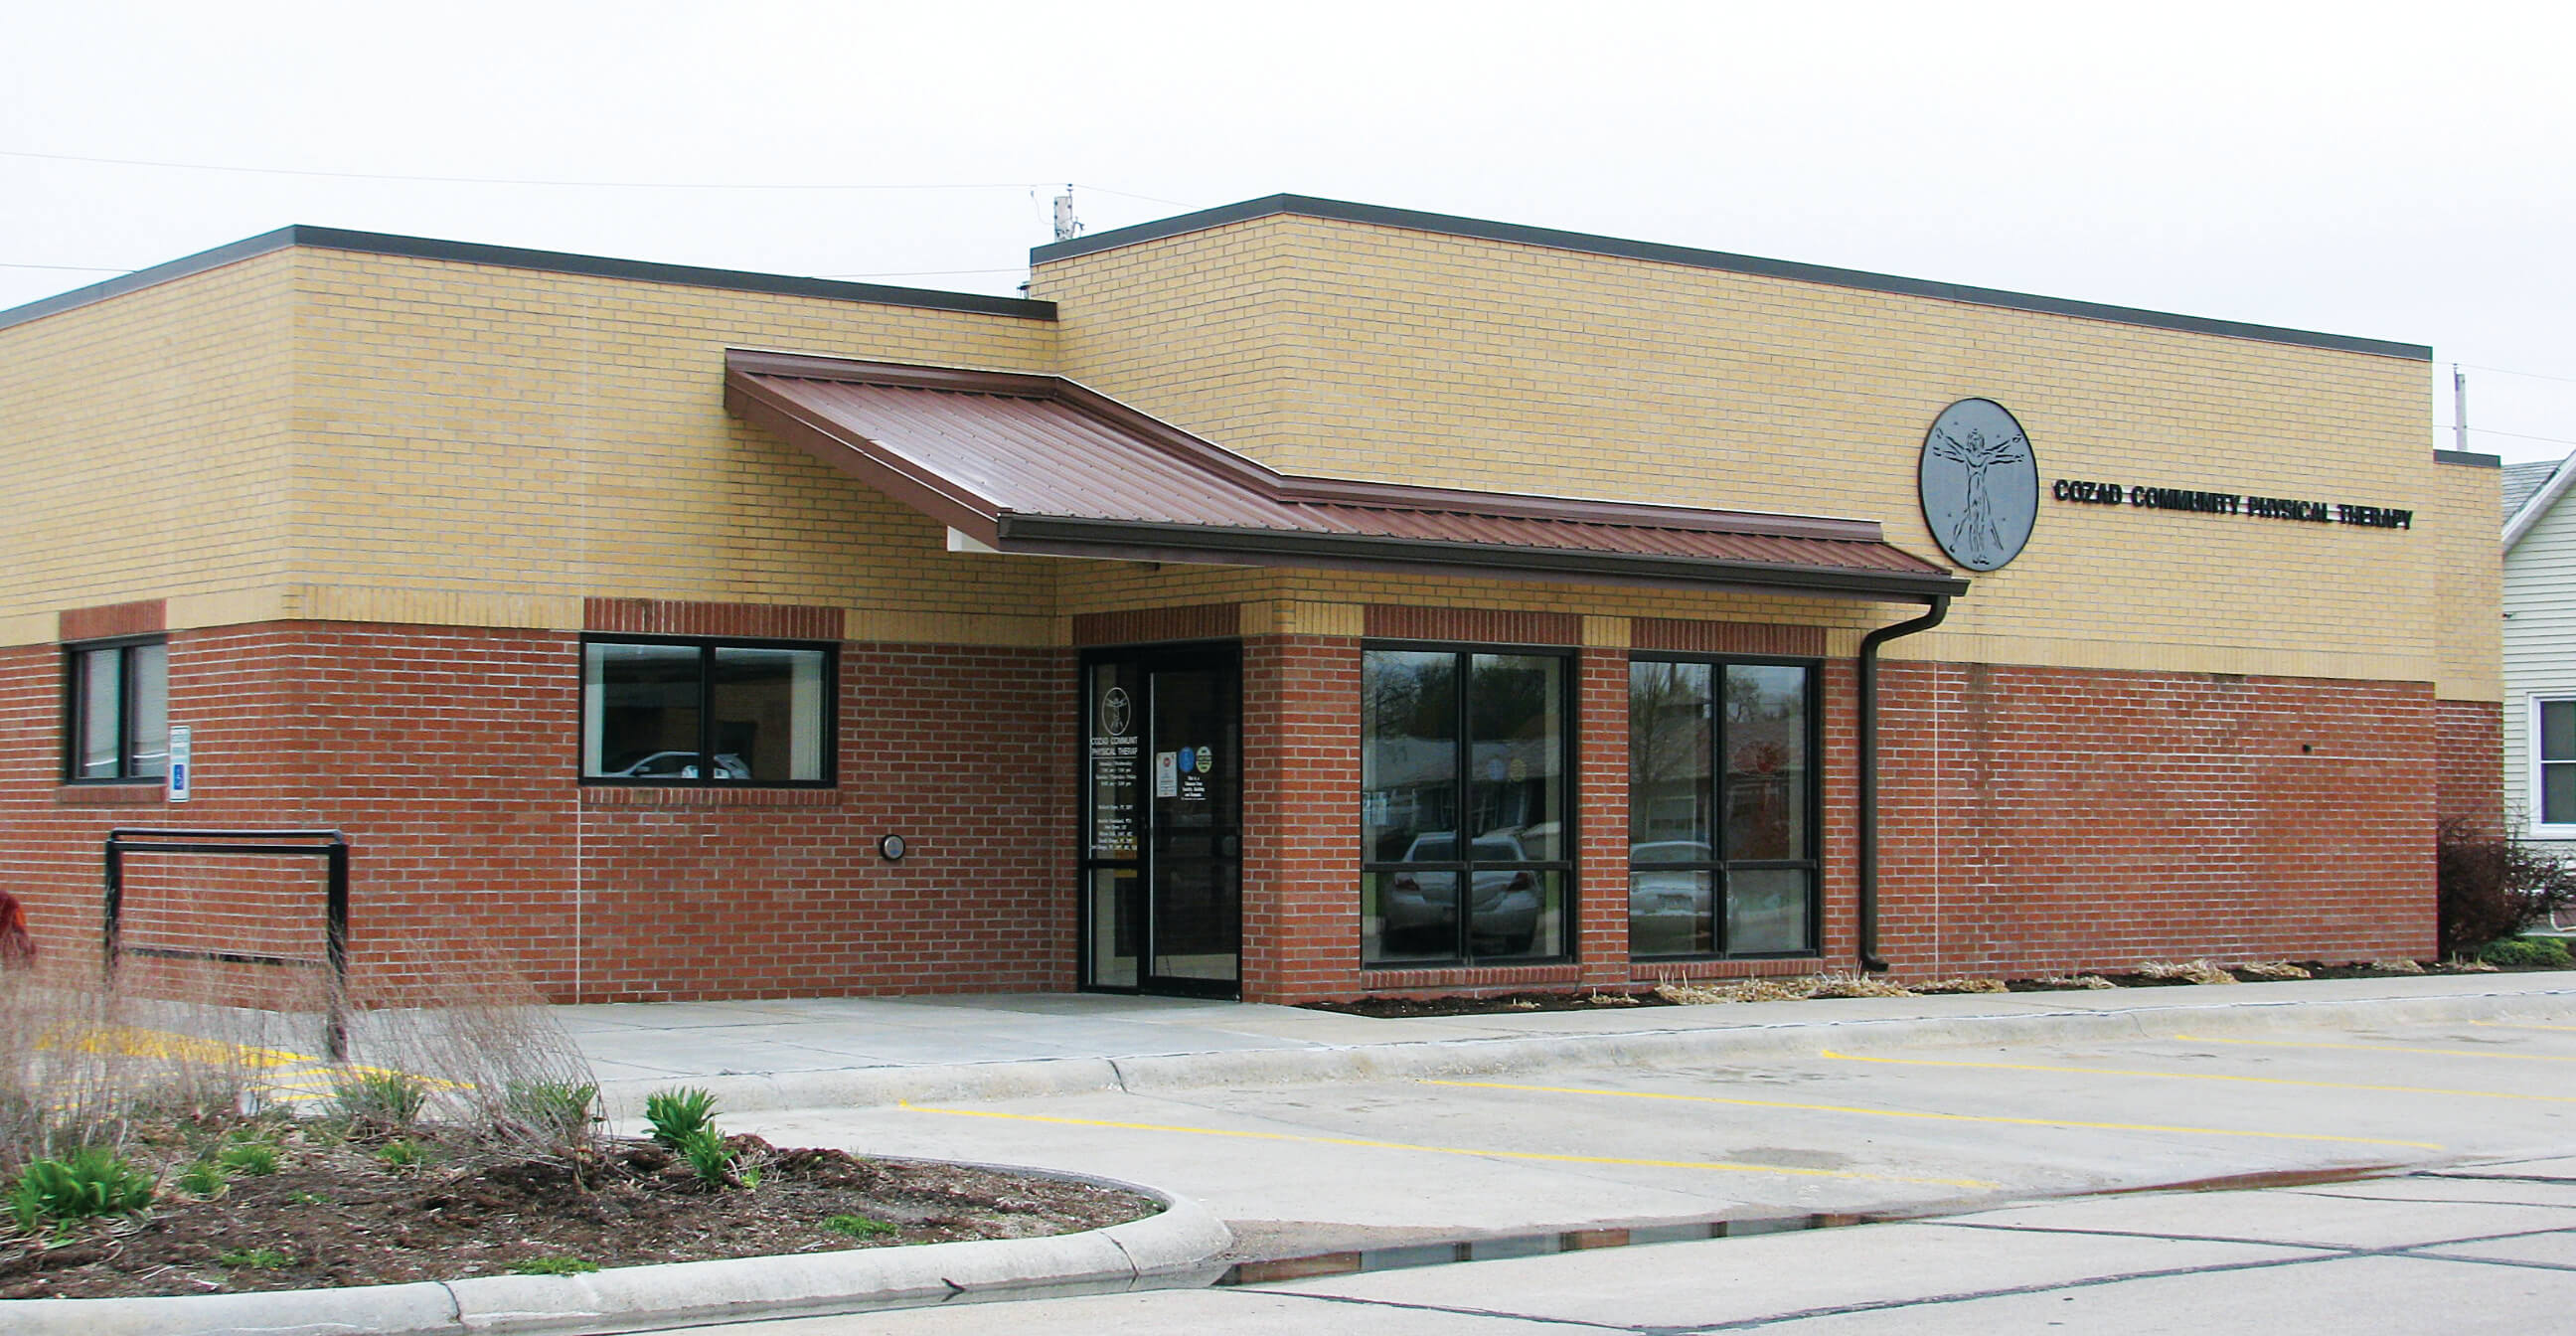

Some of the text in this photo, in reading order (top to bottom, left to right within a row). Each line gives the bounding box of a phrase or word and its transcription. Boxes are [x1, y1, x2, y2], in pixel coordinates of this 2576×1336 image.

[2053, 479, 2413, 530] COZAD COMMUNITY PHYSICAL THERAPY
